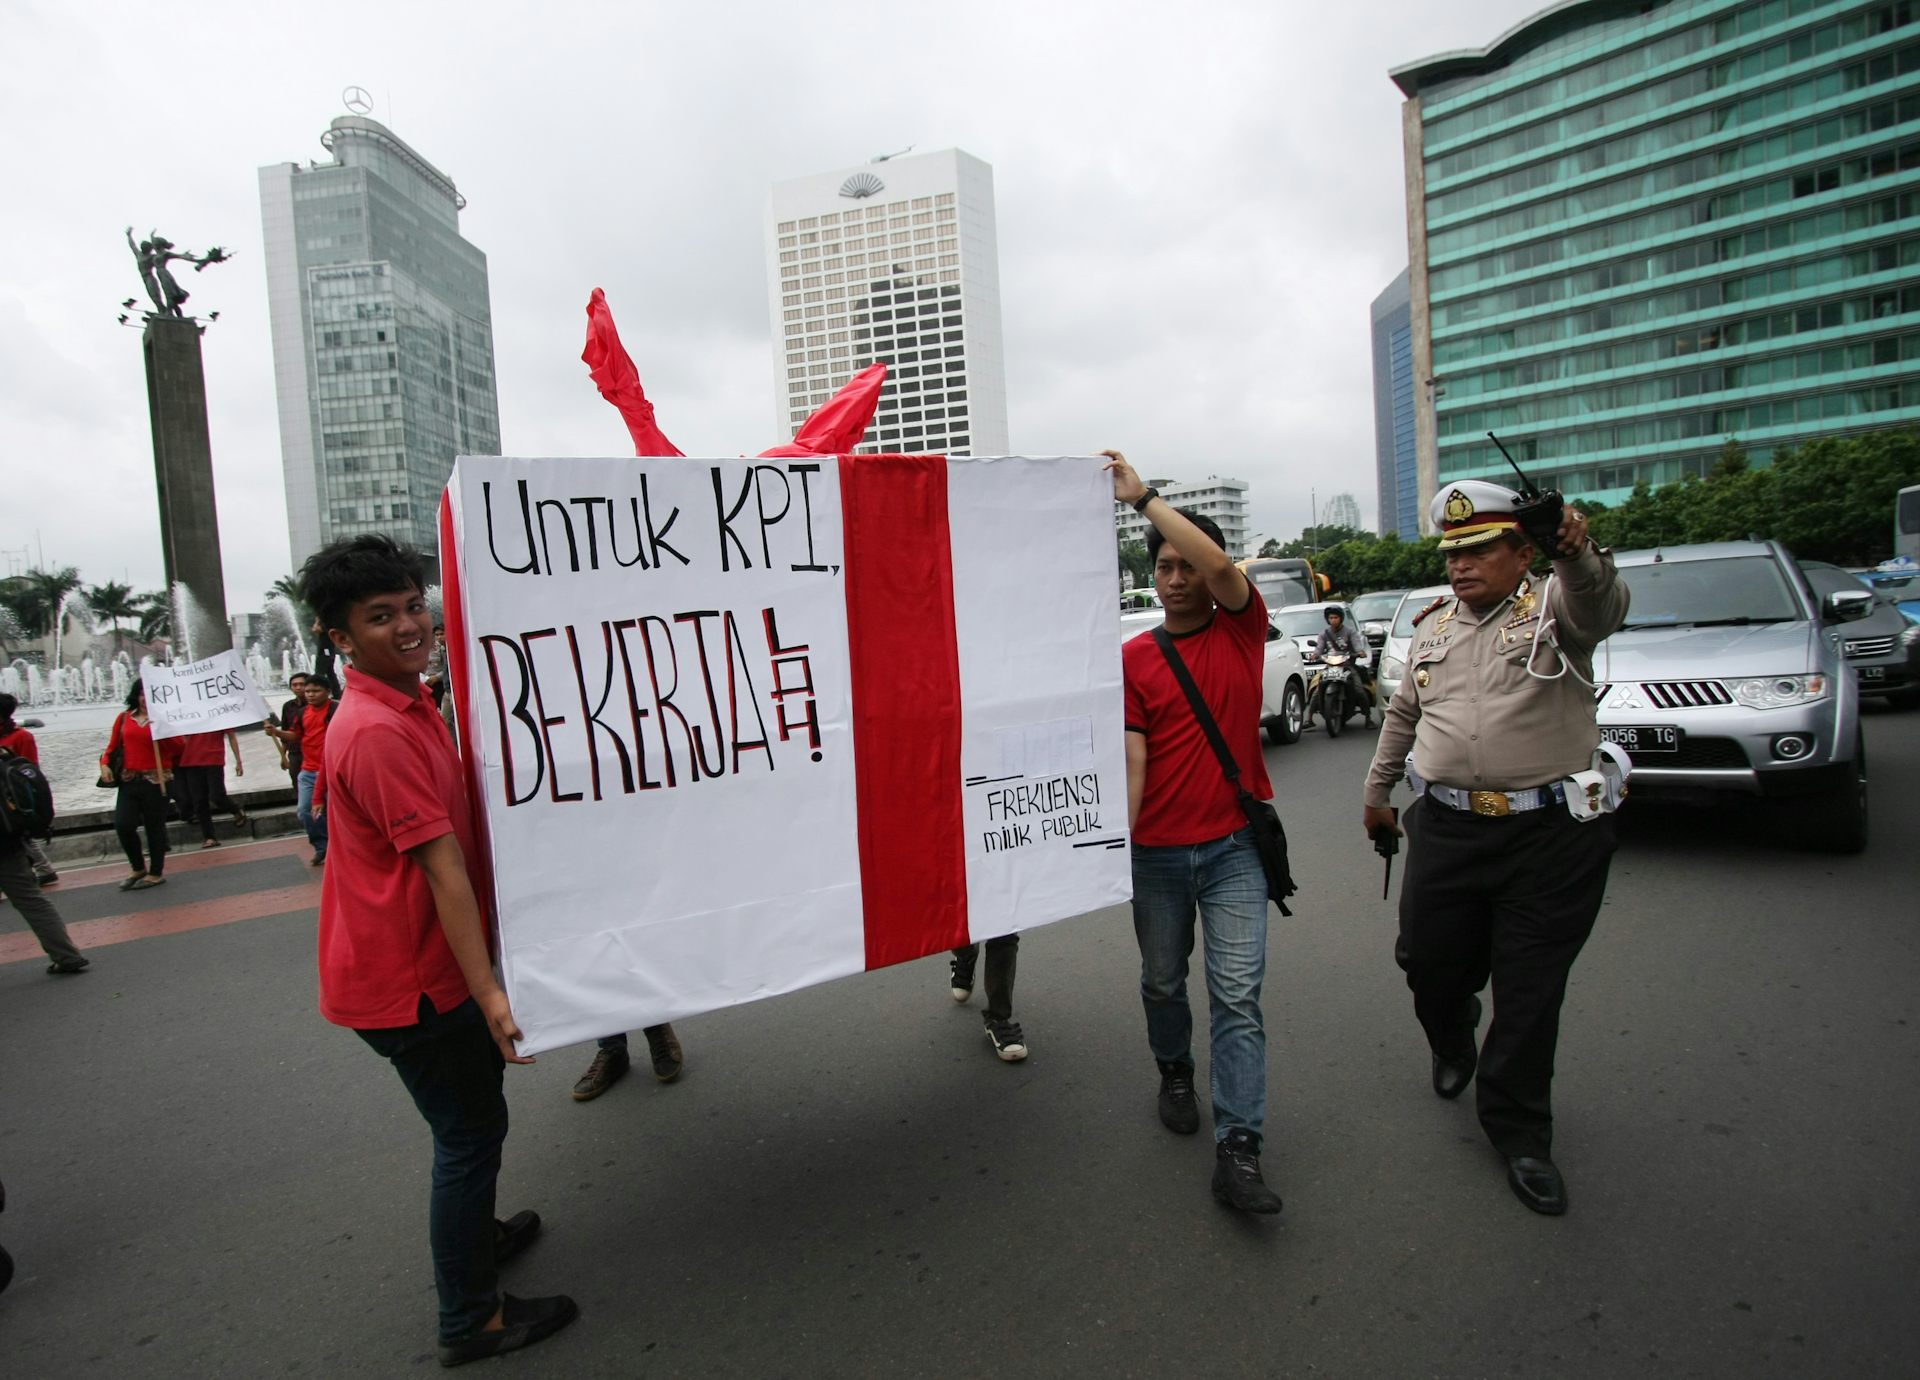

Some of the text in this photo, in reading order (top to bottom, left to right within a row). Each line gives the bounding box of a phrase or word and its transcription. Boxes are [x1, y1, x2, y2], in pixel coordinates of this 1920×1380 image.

[711, 464, 840, 576] KPI,
[1419, 635, 1452, 649] BILLY
[150, 670, 246, 704] KPI TEGAS
[1600, 728, 1674, 744] 8056 TG
[987, 774, 1100, 821] FREKUENSI
